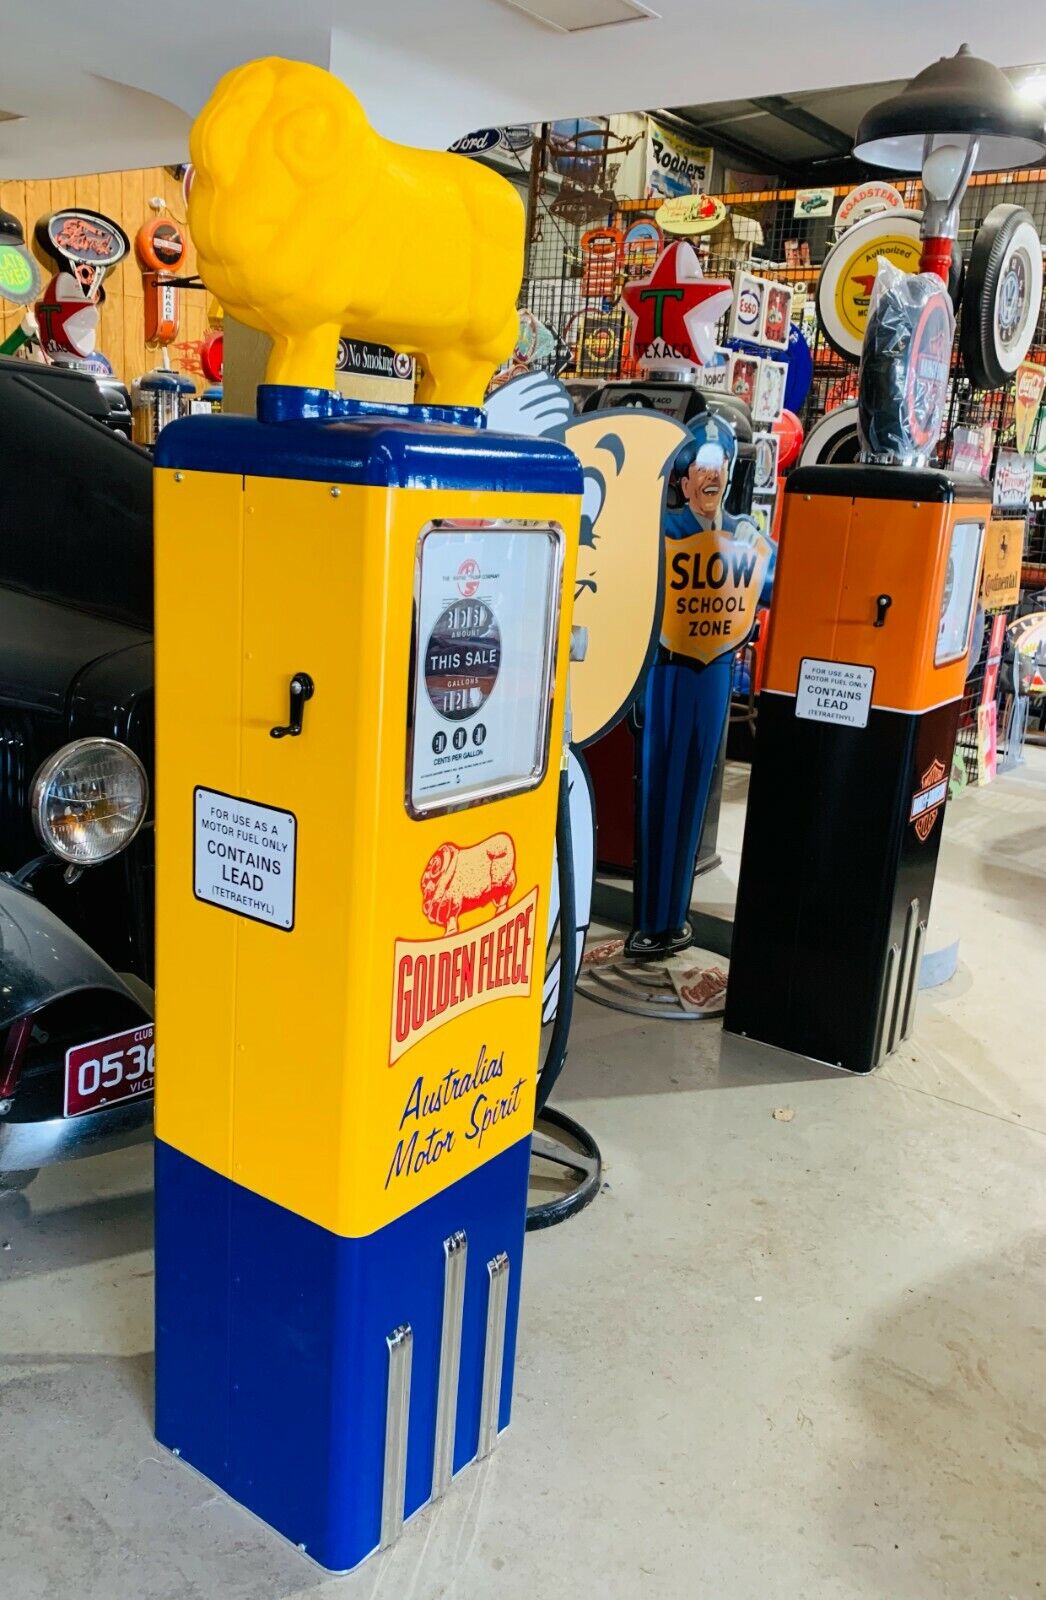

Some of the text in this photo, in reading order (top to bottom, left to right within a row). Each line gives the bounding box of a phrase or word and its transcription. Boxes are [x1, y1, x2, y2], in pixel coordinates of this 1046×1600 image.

[450, 132, 489, 151] Ford
[651, 138, 706, 181] Rodders
[840, 187, 898, 220] ROADSTERS
[865, 245, 912, 262] Authorized
[640, 289, 684, 338] T
[349, 344, 394, 377] No Smoking
[636, 342, 691, 359] TEXACO
[670, 551, 757, 591] SLOW
[676, 596, 746, 615] SCHOOL
[451, 629, 480, 639] AMOUNT
[688, 620, 732, 637] ZONE
[430, 648, 497, 671] THIS SALE
[812, 667, 826, 675] FOR
[447, 677, 479, 688] GALLONS
[804, 674, 868, 688] MOTOR FUEL ONLY
[807, 684, 862, 701] CONTAINS
[817, 697, 848, 711] LEAD
[433, 748, 484, 766] CENTS PER GALLON
[210, 807, 279, 836] FOR USE AS A
[201, 818, 288, 853] MOTOR FUEL ONLY
[207, 839, 281, 875] CONTAINS
[222, 864, 264, 892] LEAD
[212, 884, 275, 916] (TETRAETHYL)
[395, 903, 534, 1043] GOLDEN FLEECE
[134, 1027, 153, 1042] CLUB
[399, 1044, 504, 1131] Australias
[384, 1078, 527, 1191] Motor Spirit
